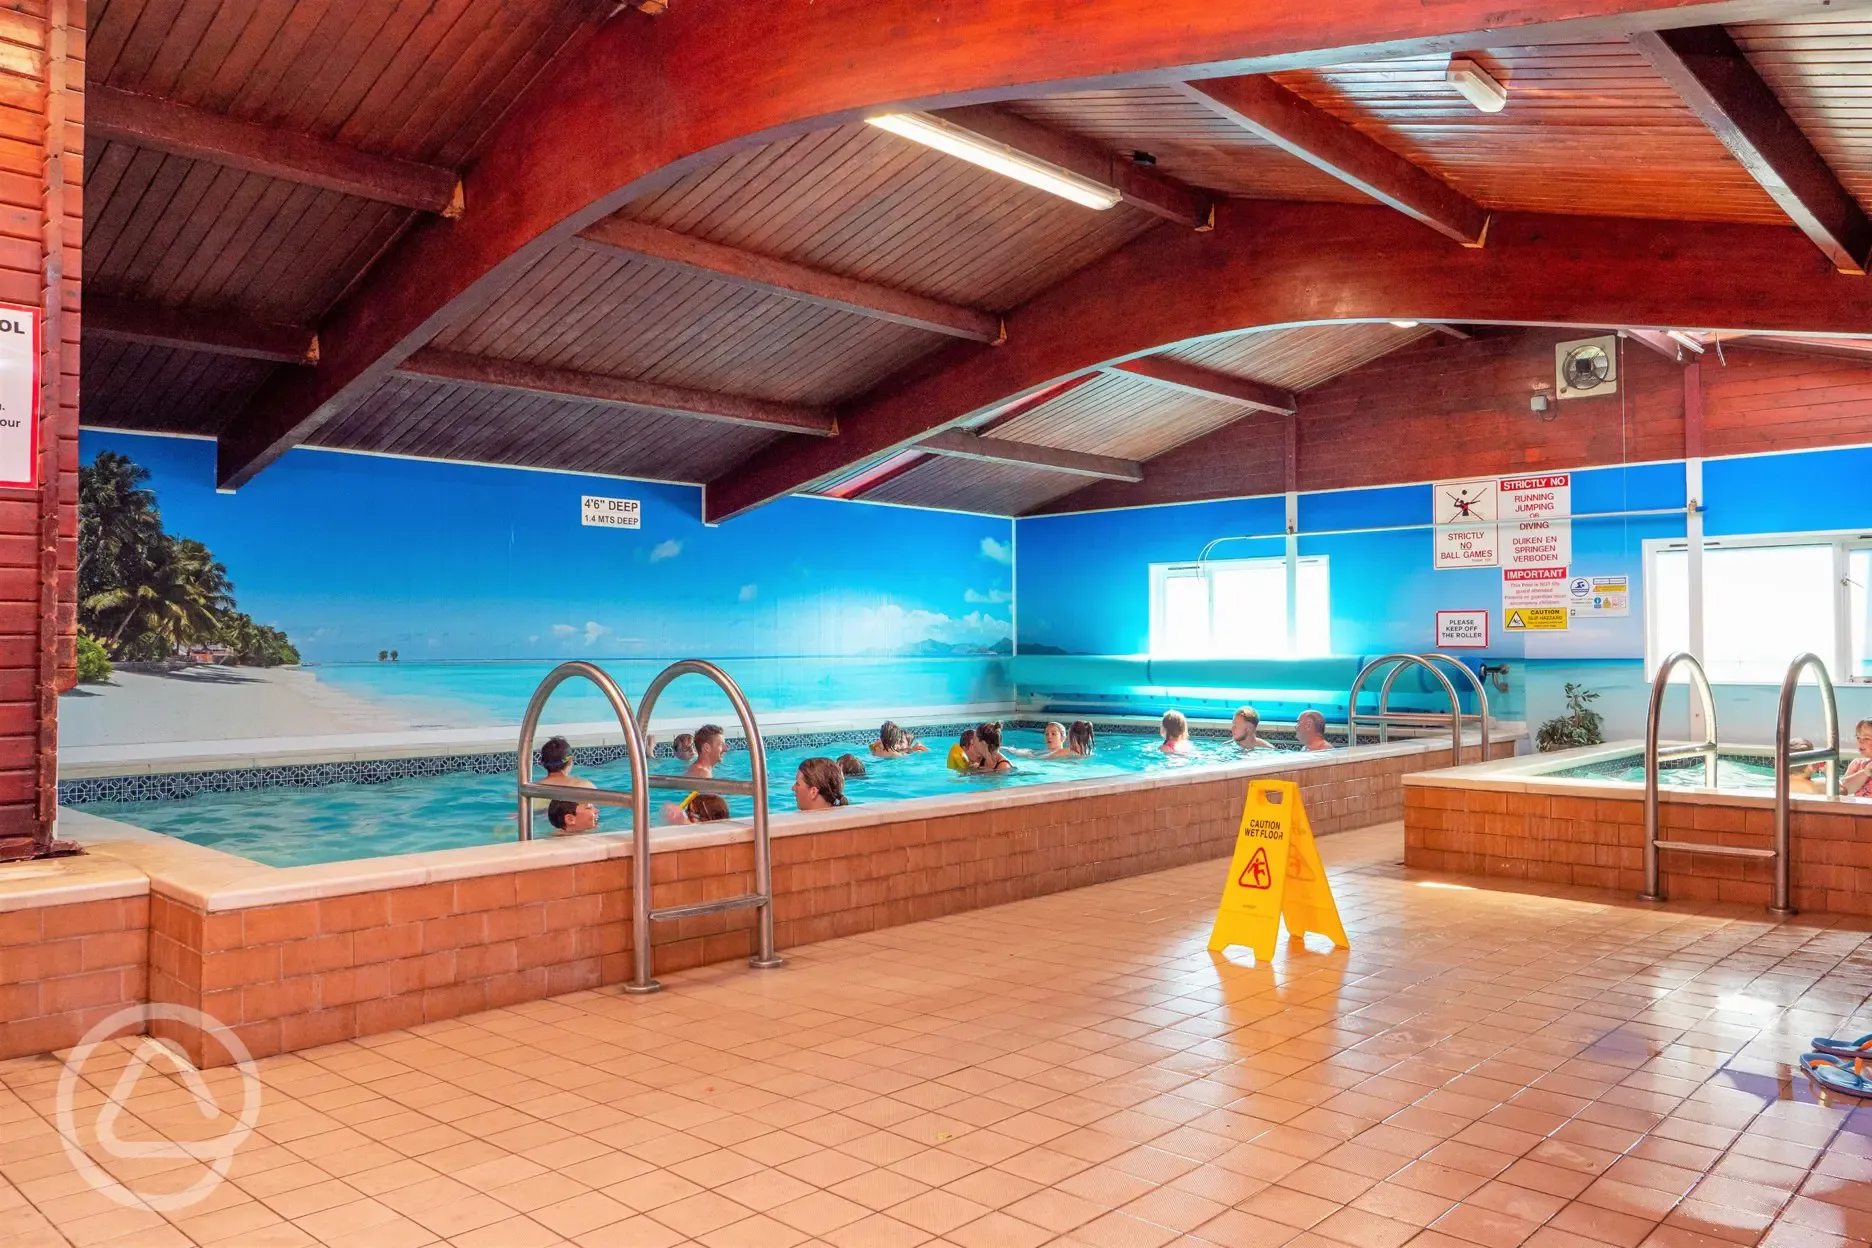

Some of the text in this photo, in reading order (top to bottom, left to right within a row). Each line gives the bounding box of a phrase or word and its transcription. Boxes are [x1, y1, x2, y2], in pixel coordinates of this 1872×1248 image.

[1503, 476, 1566, 490] STRICTLY NO
[1514, 492, 1555, 503] RUNNING
[584, 498, 638, 512] 4'6" DEEP
[1514, 502, 1555, 513] JUMPING
[584, 514, 639, 526] 1.4 MTS DEEP
[1519, 520, 1550, 531] DIVING
[1447, 531, 1485, 541] STRICTLY
[1512, 535, 1557, 546] DUIKEN EN
[1460, 541, 1473, 550] NO
[1514, 545, 1556, 554] SPRINGEN
[1440, 549, 1493, 560] BALL GAMES
[1512, 553, 1558, 563] VERBODEN
[1507, 569, 1564, 579] IMPORTANT
[1249, 819, 1281, 830] CAUTION
[1244, 828, 1260, 838] WET
[1260, 829, 1284, 841] FLOOR
